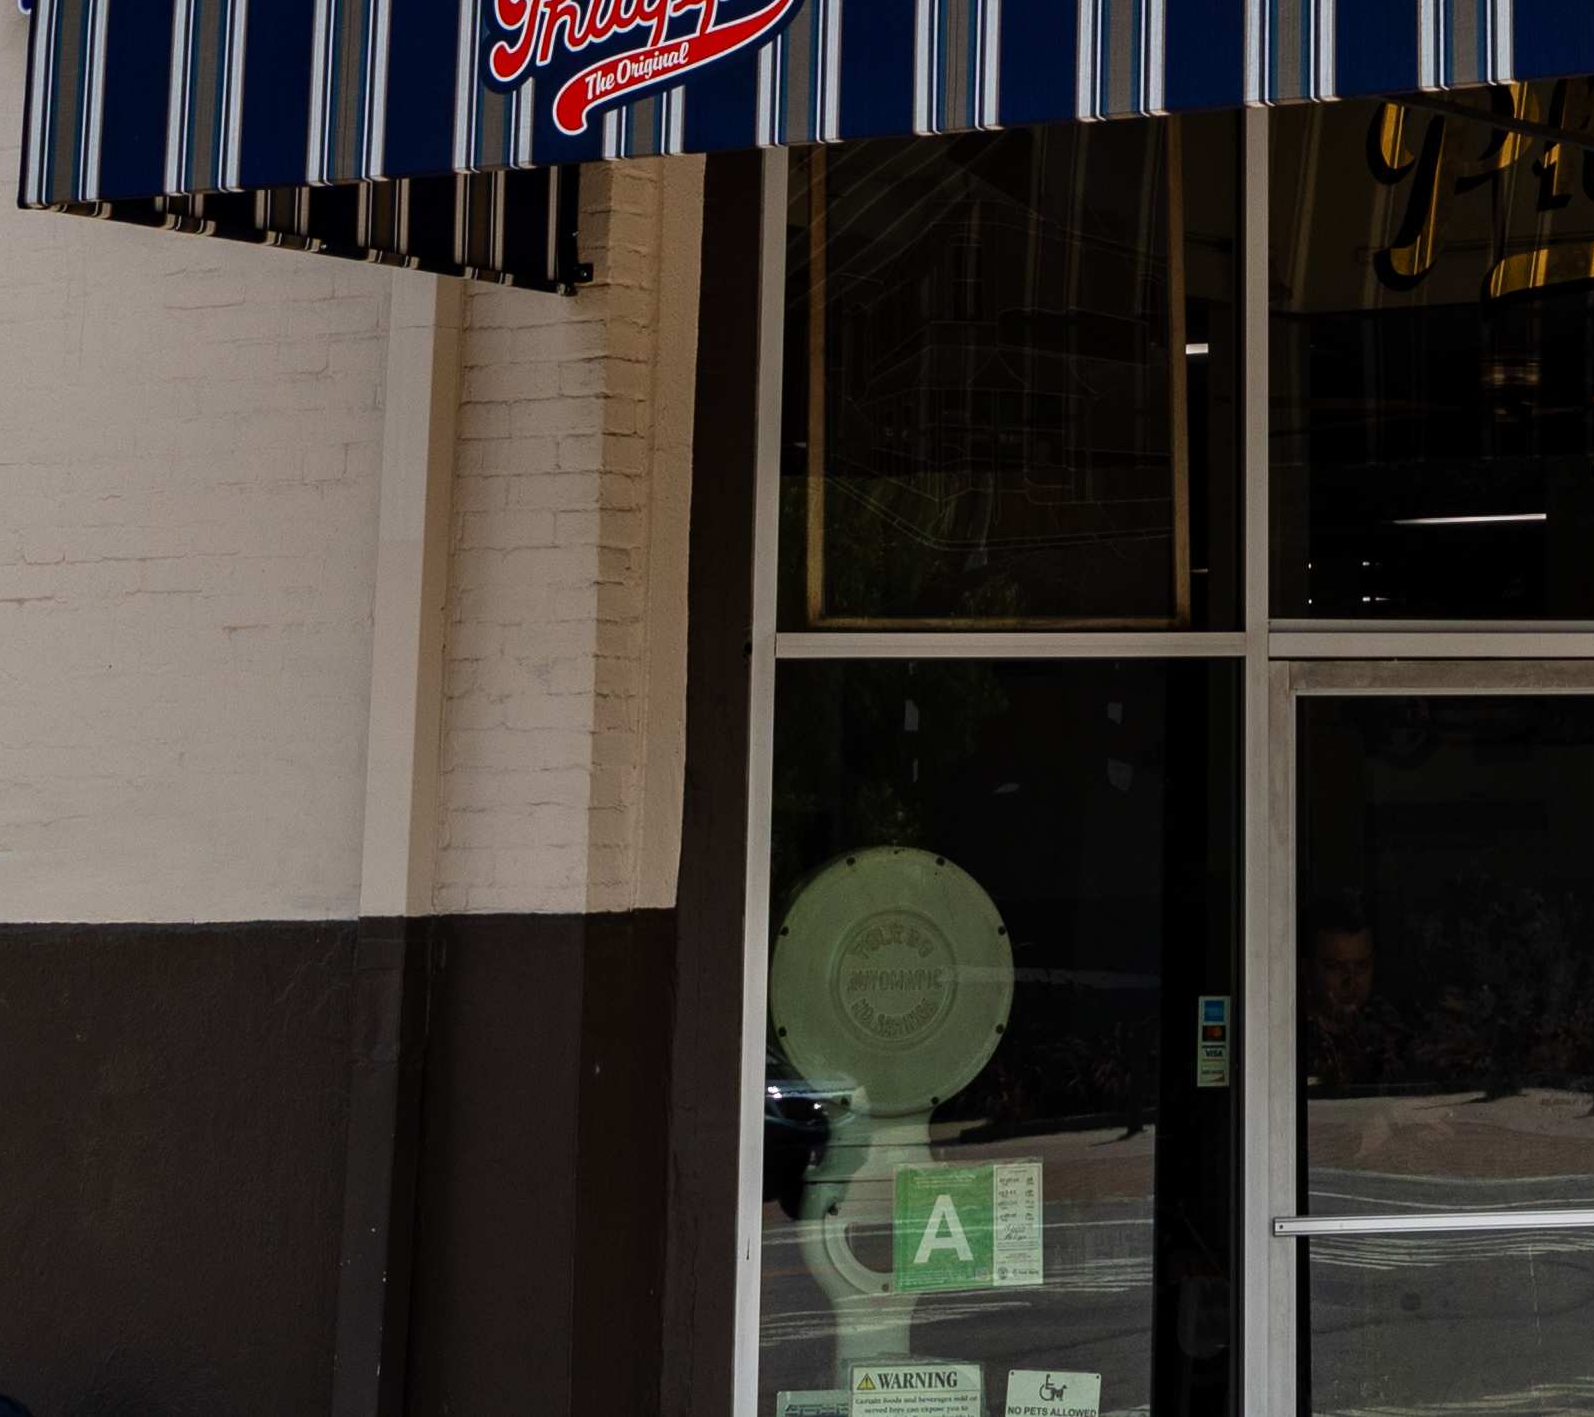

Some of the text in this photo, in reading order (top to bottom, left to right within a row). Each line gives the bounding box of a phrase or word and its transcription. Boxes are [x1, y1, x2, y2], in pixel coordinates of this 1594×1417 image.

[585, 41, 689, 101] The Original
[913, 1194, 975, 1264] A
[877, 1371, 958, 1390] WARNING
[1007, 1406, 1097, 1417] NO PETS ALLOWED
